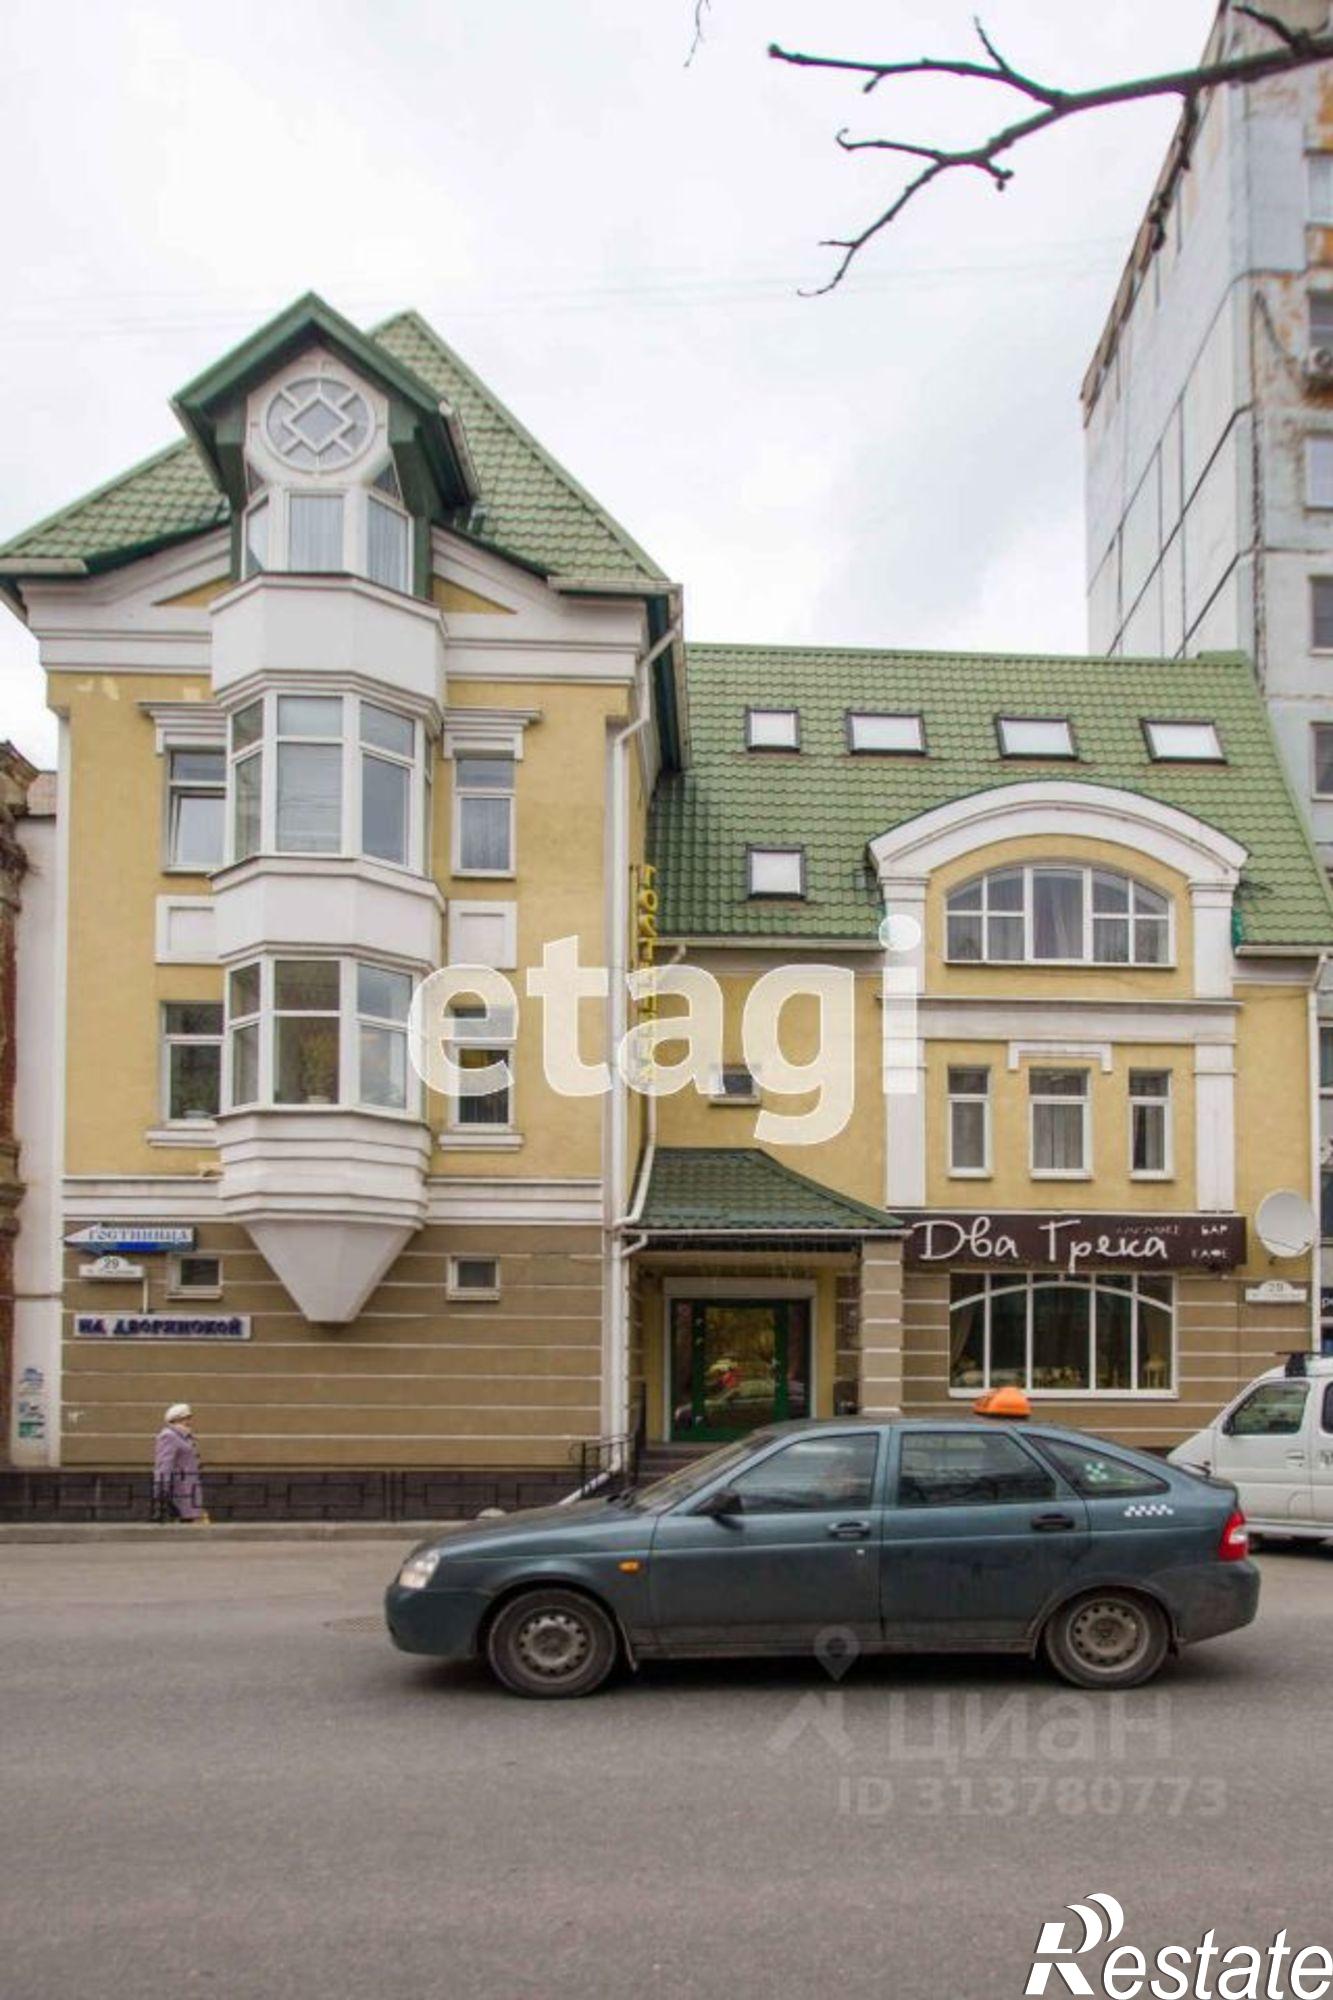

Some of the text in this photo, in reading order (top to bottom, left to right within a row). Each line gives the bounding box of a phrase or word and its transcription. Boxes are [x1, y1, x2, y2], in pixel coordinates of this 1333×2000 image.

[912, 1216, 1169, 1274] Два Грека
[103, 1257, 119, 1269] 29
[78, 1318, 107, 1334] НА
